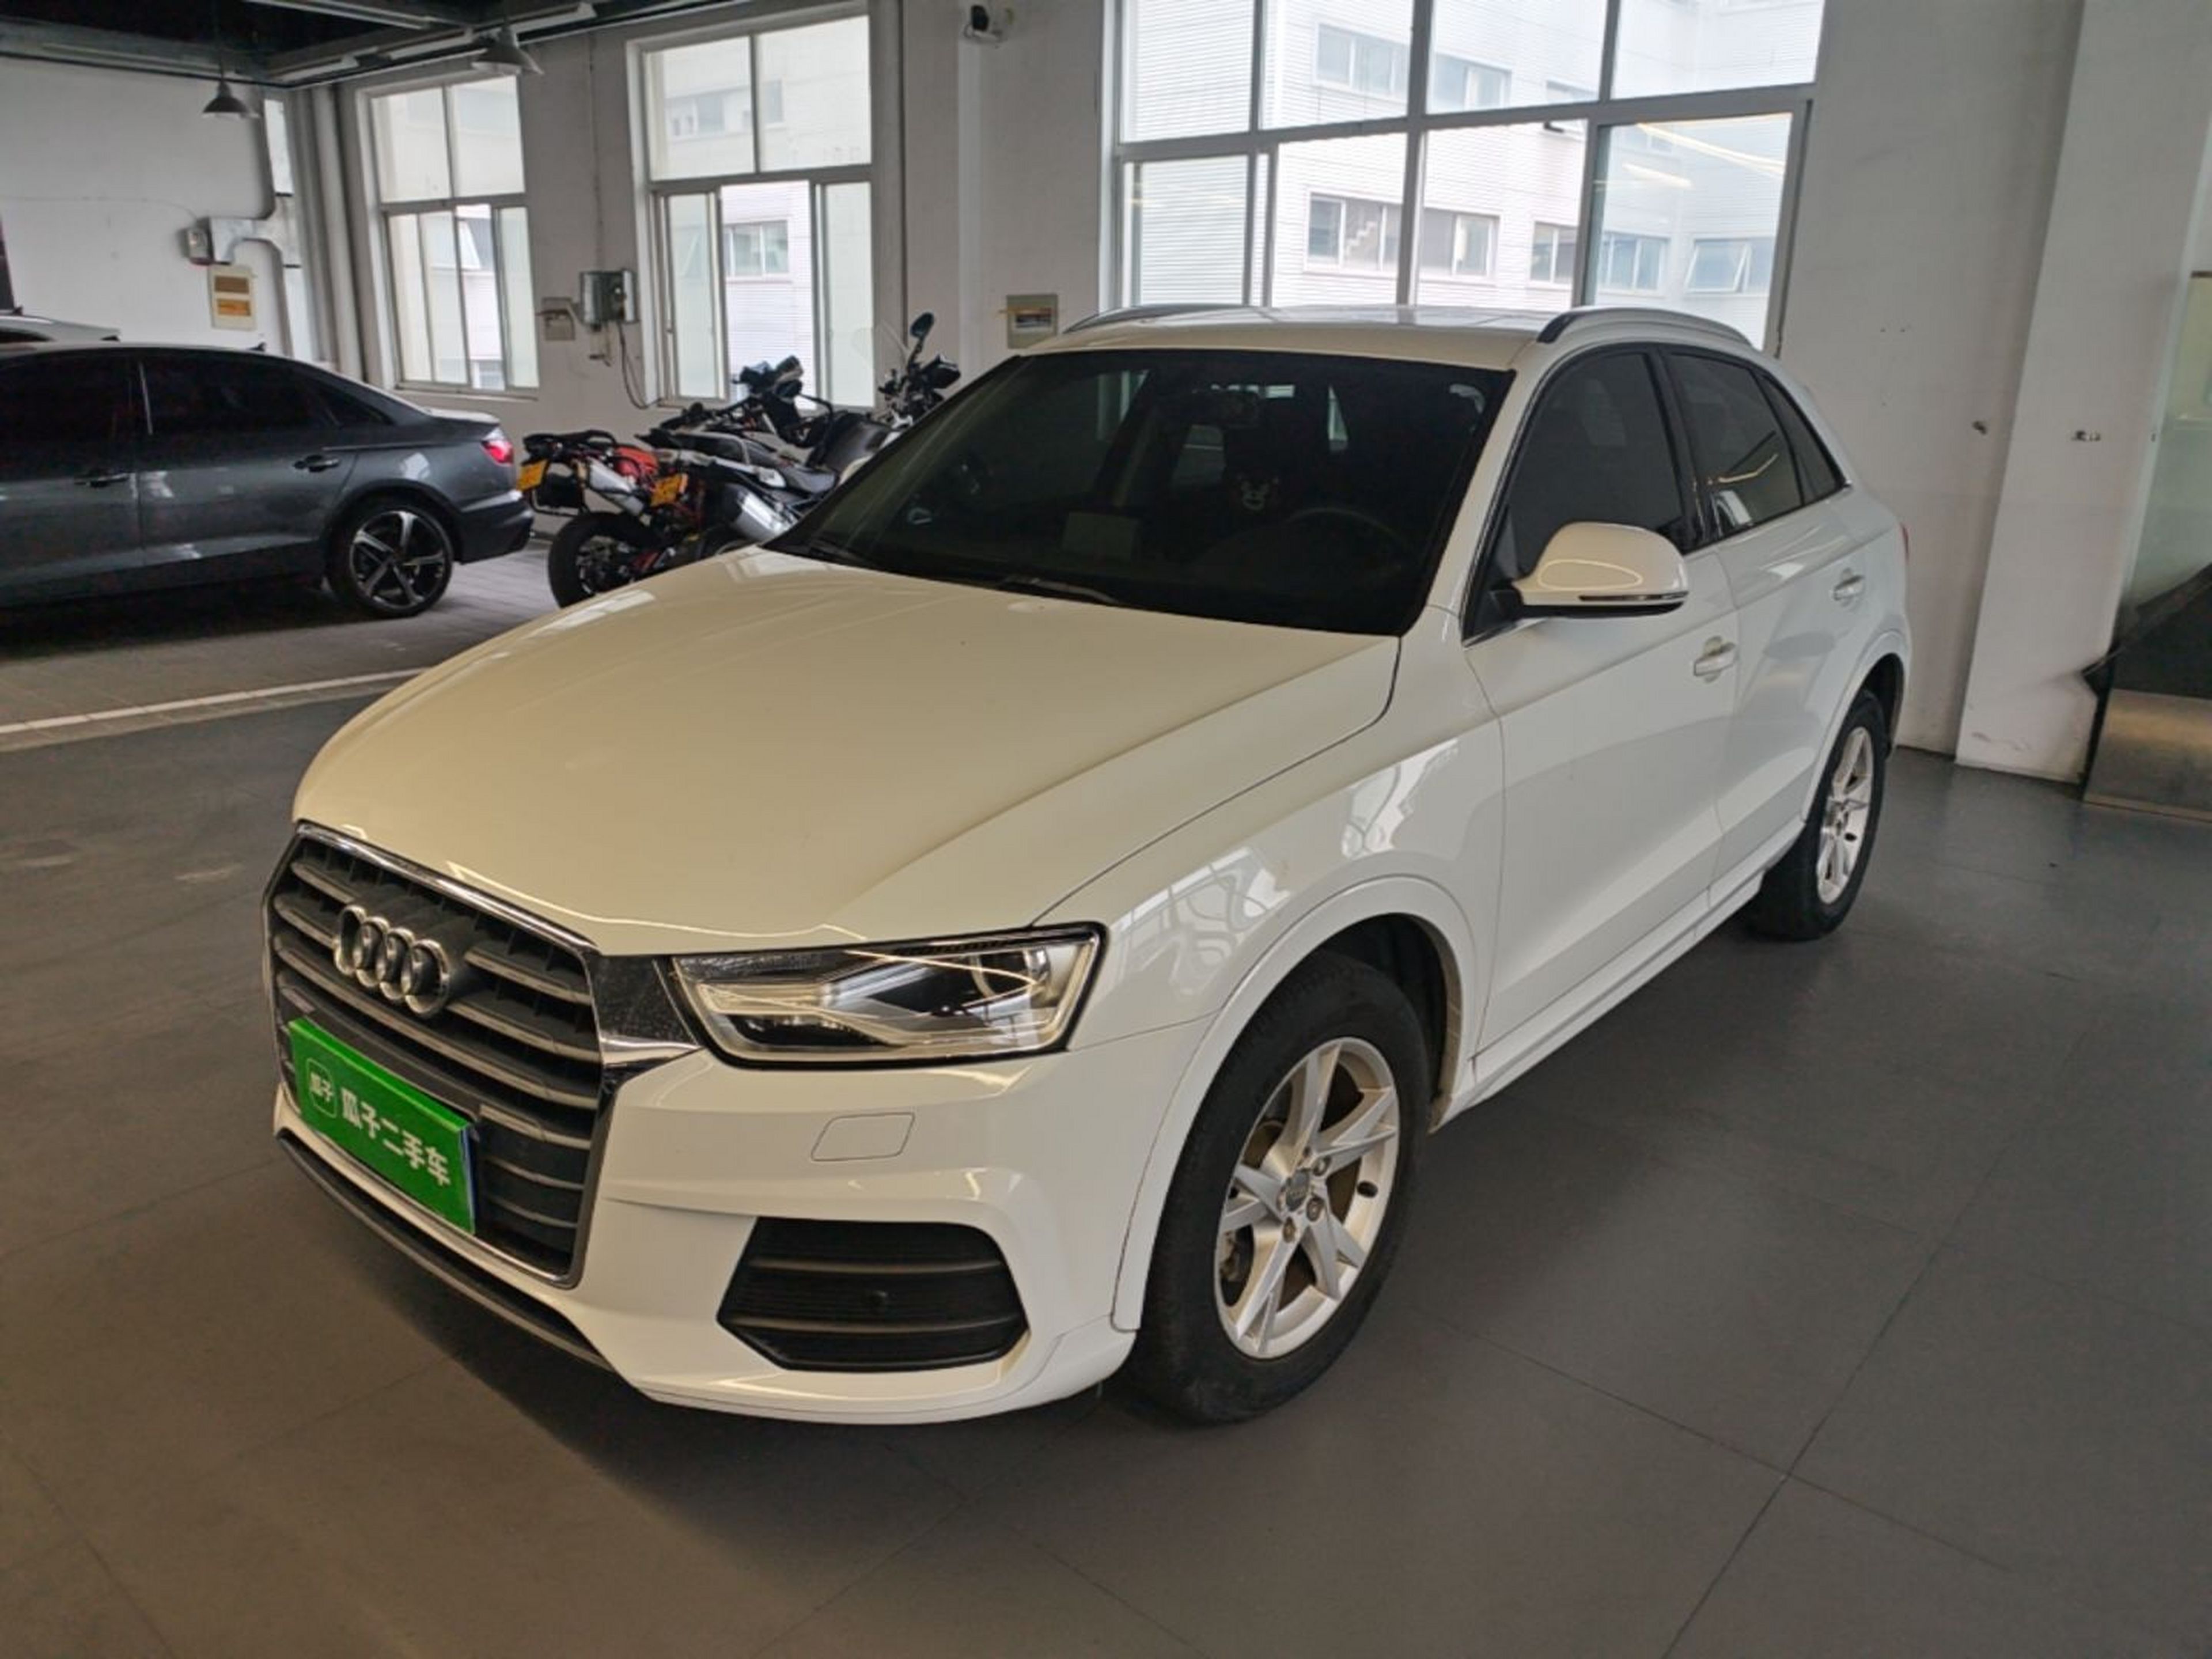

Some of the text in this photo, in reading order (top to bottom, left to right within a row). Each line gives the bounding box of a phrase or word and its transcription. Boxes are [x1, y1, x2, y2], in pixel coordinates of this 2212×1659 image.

[341, 1087, 450, 1186] 瓜子二手车
